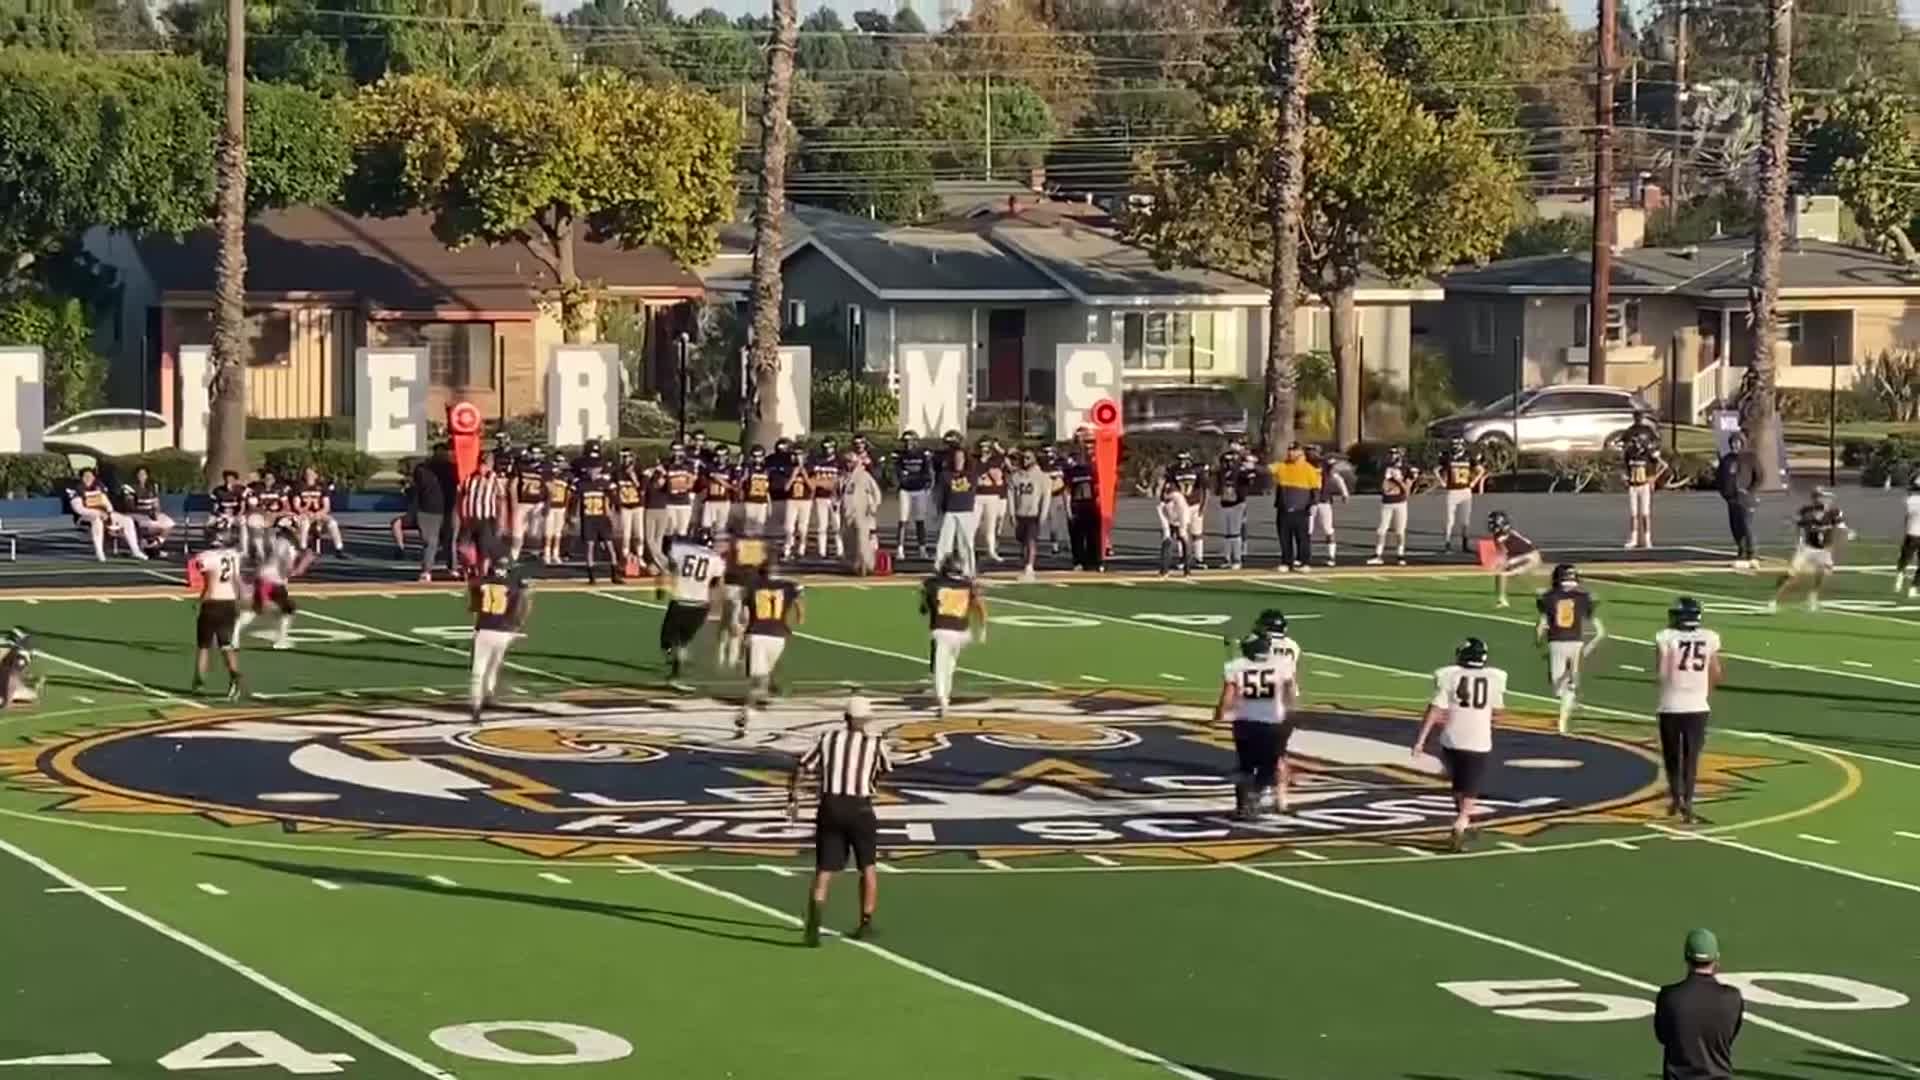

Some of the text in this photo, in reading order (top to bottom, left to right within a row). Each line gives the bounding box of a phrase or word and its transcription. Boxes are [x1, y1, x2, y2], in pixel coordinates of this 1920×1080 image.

[681, 555, 710, 582] 60
[1677, 640, 1708, 672] 75
[1242, 669, 1276, 700] 55
[1454, 676, 1489, 710] 40
[1436, 970, 1910, 1024] 50
[157, 1020, 635, 1075] 40
